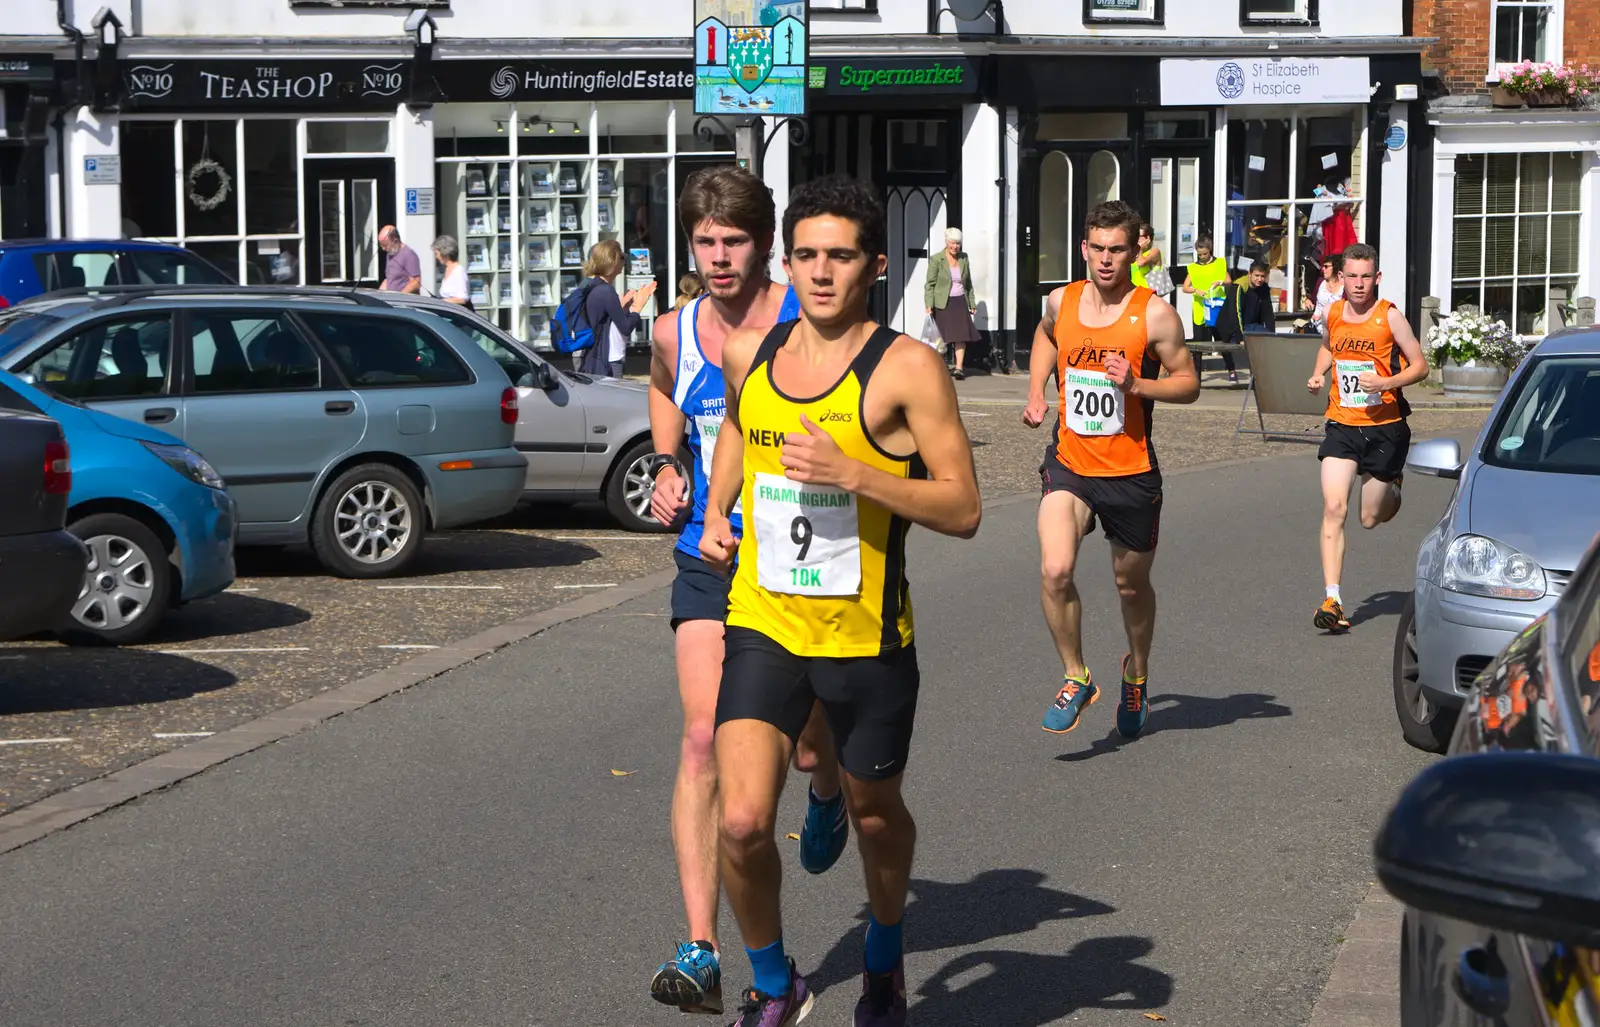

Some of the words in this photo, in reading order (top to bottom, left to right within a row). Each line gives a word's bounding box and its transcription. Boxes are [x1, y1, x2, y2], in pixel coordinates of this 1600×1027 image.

[255, 67, 279, 78] THE
[839, 63, 964, 92] Supermarket
[1252, 63, 1263, 77] St
[1266, 63, 1320, 77] Elizabeth
[200, 71, 333, 99] TEASHOP
[1253, 81, 1301, 98] Hospice
[1335, 338, 1375, 352] JAFFA
[1073, 389, 1115, 418] 200
[1084, 420, 1103, 431] 10K
[759, 485, 850, 508] FRAMLINGHAM
[790, 515, 813, 562] 9
[789, 568, 822, 587] 10K
